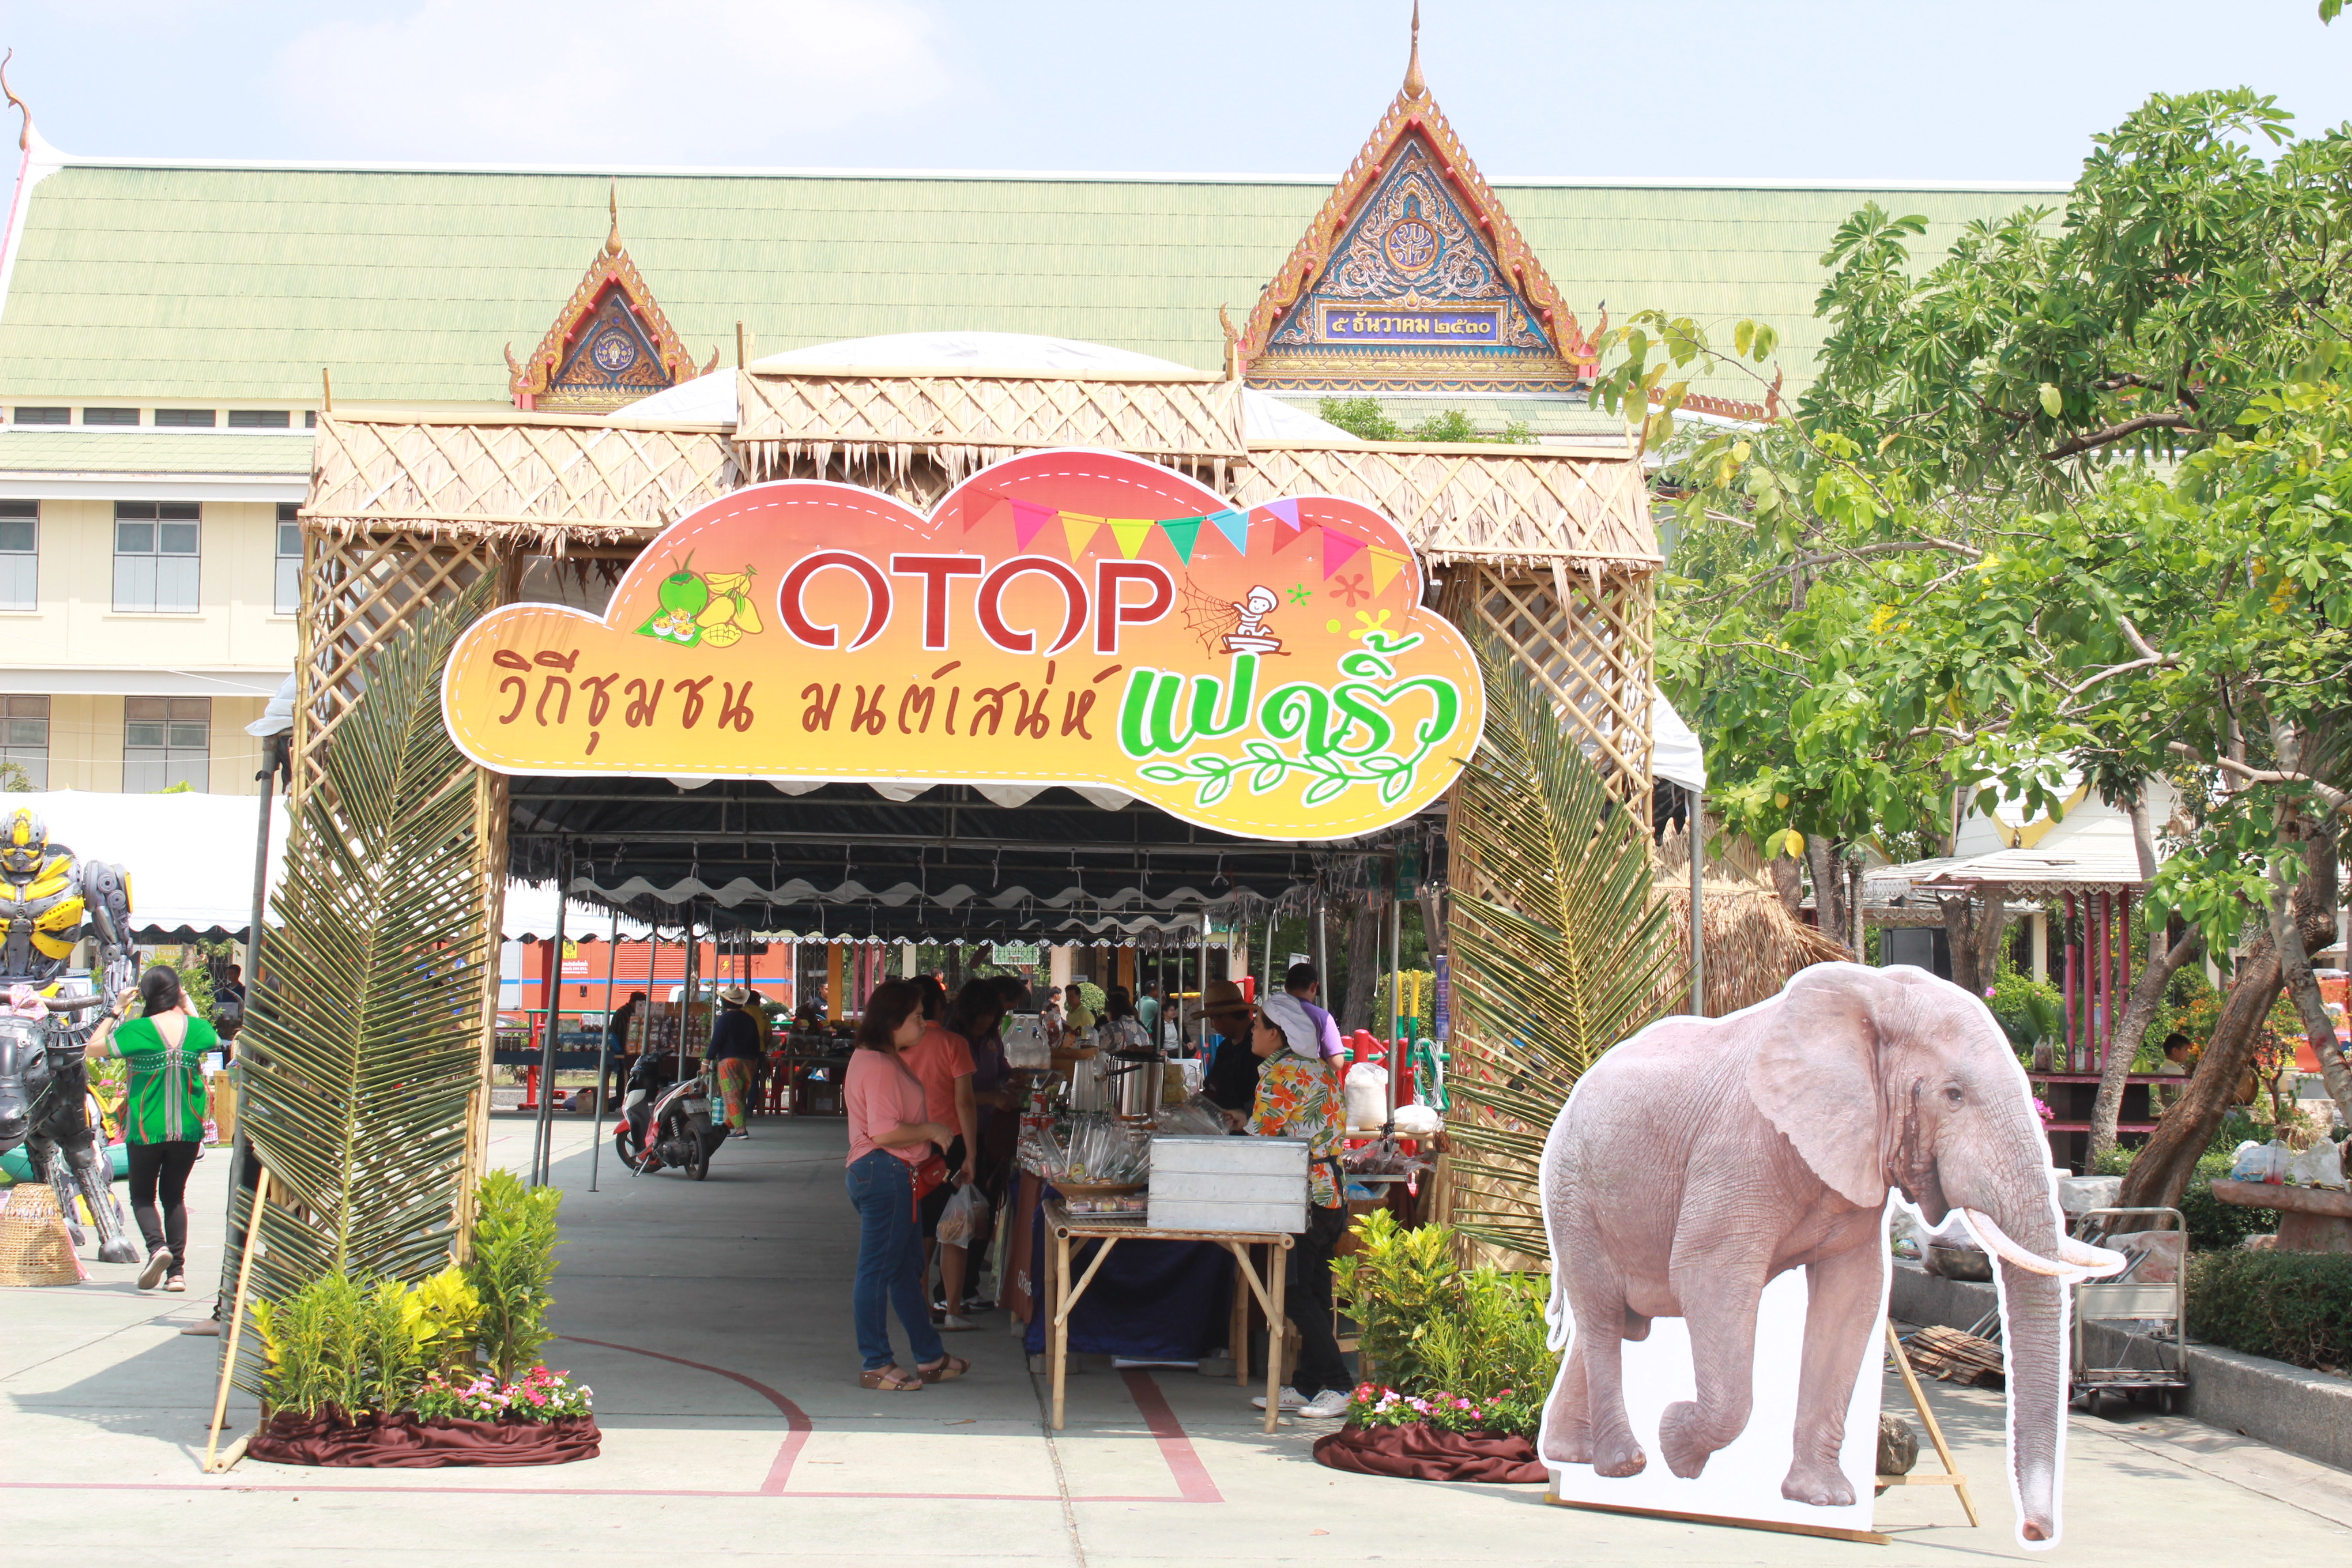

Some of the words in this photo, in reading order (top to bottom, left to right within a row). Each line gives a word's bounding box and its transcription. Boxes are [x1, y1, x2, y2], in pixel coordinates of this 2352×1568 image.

[1331, 316, 1350, 333] ๕
[1352, 311, 1430, 333] ธันวาคม
[1433, 318, 1491, 334] ๒๕๓๐
[778, 551, 1175, 655] OTOP
[492, 649, 755, 756] วิถีชุมชน
[800, 659, 1123, 740] มนต์เสน่ห์
[1120, 632, 1459, 758] แปดริ้ว
